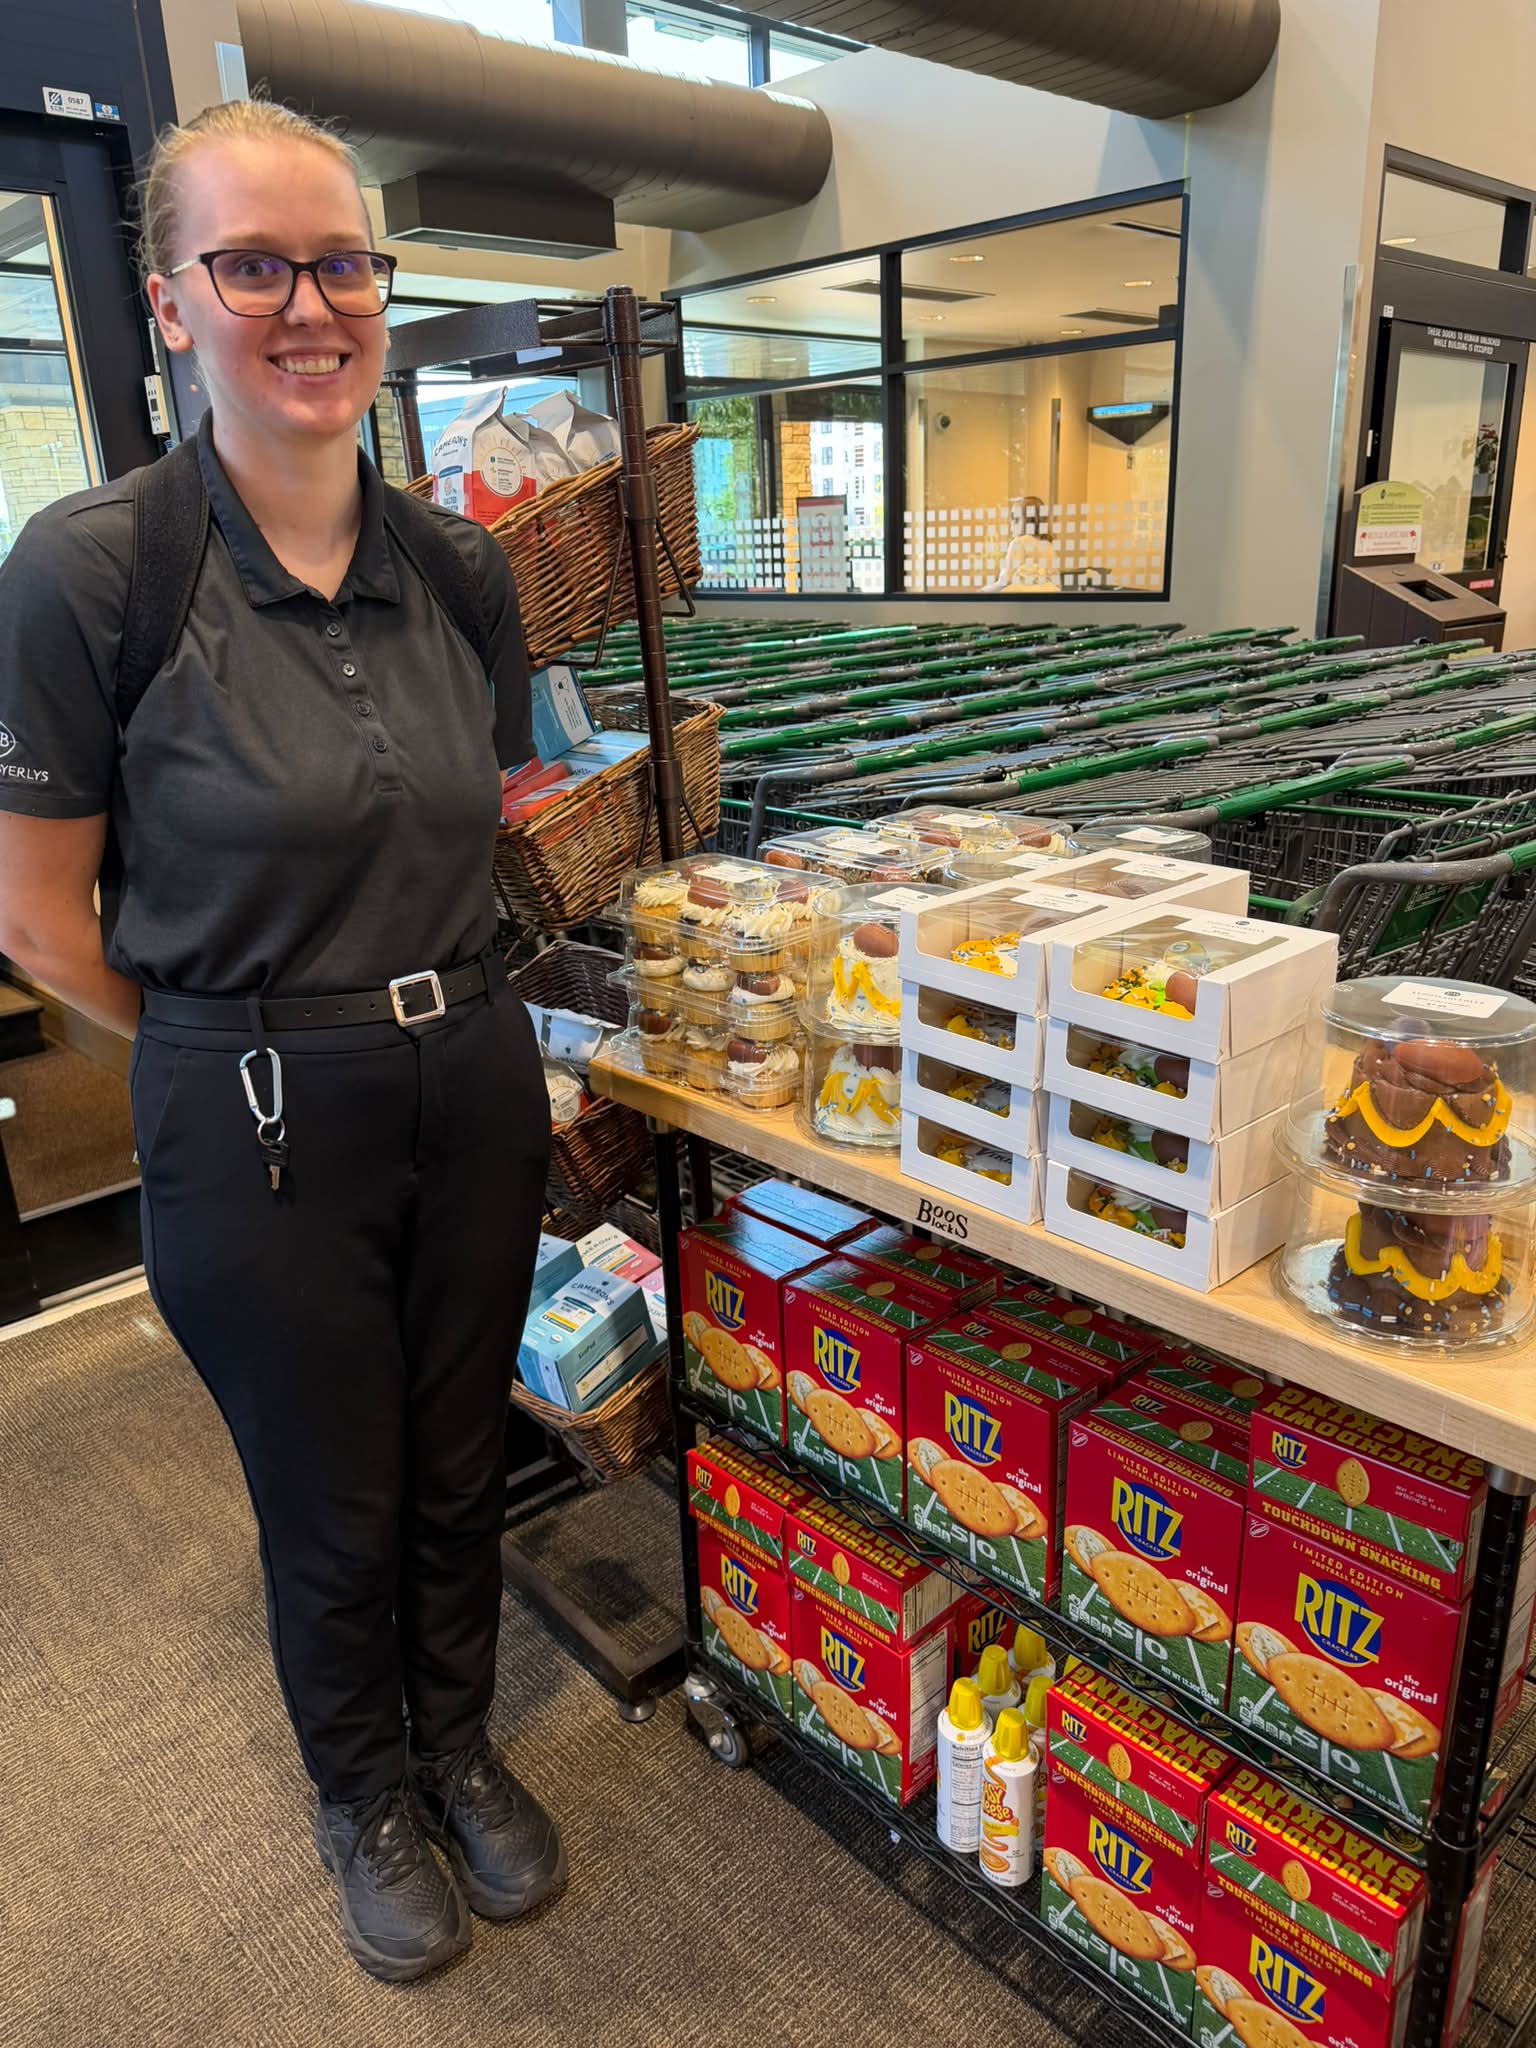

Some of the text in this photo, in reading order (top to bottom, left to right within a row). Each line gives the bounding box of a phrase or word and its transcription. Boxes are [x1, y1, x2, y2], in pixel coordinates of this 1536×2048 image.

[0, 763, 49, 782] YERLYS
[705, 1268, 746, 1327] RITZ
[808, 1301, 870, 1337] LIMITED EDITION
[849, 1305, 898, 1334] SNACKING
[749, 1333, 775, 1351] original
[962, 1322, 993, 1338] RITZ
[988, 1310, 1107, 1366] TOUCHDOWN SNACKING
[813, 1325, 861, 1388] RITZ
[922, 1343, 1044, 1405] TOUCHDOWN SNACKING
[1183, 1354, 1217, 1374] RITZ
[865, 1397, 896, 1417] original
[938, 1364, 1013, 1407] LIMITED EDITION
[1130, 1394, 1167, 1415] RITZ
[1147, 1379, 1226, 1417] TOUCHDOWN
[944, 1390, 1002, 1462] RITZ
[1262, 1401, 1473, 1491] TOUCHDOWN
[1271, 1430, 1308, 1465] RITZ
[1277, 1387, 1484, 1477] SNACKING
[695, 1465, 712, 1487] RITZ
[1018, 1467, 1030, 1478] the
[1087, 1420, 1234, 1498] TOUCHDOWN SNACKING
[1107, 1448, 1198, 1500] LIMITED EDITION
[1006, 1471, 1042, 1494] original
[695, 1509, 741, 1544] TOUCHDOWN
[741, 1538, 778, 1568] SNACKING
[1111, 1476, 1184, 1558] RITZ
[795, 1506, 909, 1579] TOUCHDOWN
[797, 1529, 817, 1555] RITZ
[1134, 1535, 1165, 1556] CRACKERS
[1262, 1501, 1356, 1553] TOUCHDOWN
[1359, 1545, 1441, 1591] SNACKING
[720, 1552, 758, 1614] RITZ
[1185, 1568, 1228, 1595] original
[1201, 1565, 1214, 1577] the
[1292, 1540, 1343, 1571] LIMITED
[1349, 1564, 1404, 1600] EDITION
[1311, 1560, 1349, 1581] FOOTBALL
[1350, 1577, 1380, 1597] SHAPES
[760, 1622, 786, 1641] original
[794, 1576, 846, 1617] TOUCHDOWN
[847, 1607, 891, 1644] SNACKING
[815, 1604, 842, 1626] LIMITED
[844, 1622, 873, 1649] EDITION
[968, 1608, 1007, 1654] RITZ
[1294, 1572, 1385, 1665] RITZ
[820, 1625, 866, 1690] RITZ
[1321, 1637, 1359, 1662] CRACKERS
[1384, 1677, 1438, 1705] original
[1403, 1674, 1420, 1687] the
[868, 1699, 897, 1721] original
[1055, 1680, 1208, 1785] TOUCHDOWN
[1061, 1710, 1087, 1742] RITZ
[1070, 1666, 1229, 1770] SNACKING
[1056, 1761, 1124, 1815] TOUCHDOWN
[1125, 1808, 1184, 1857] SNACKING
[1231, 1768, 1421, 1892] SNACKING
[1088, 1814, 1153, 1894] RITZ
[1217, 1786, 1402, 1910] TOUCHDOWN
[1225, 1819, 1257, 1856] RITZ
[1155, 1903, 1195, 1933] original
[1169, 1904, 1181, 1915] the
[1217, 1875, 1300, 1937] TOUCHDOWN
[1302, 1931, 1373, 1988] SNACKING
[1244, 1908, 1290, 1939] LIMITED
[1293, 1940, 1342, 1977] EDITION
[1249, 1933, 1328, 2024] RITZ
